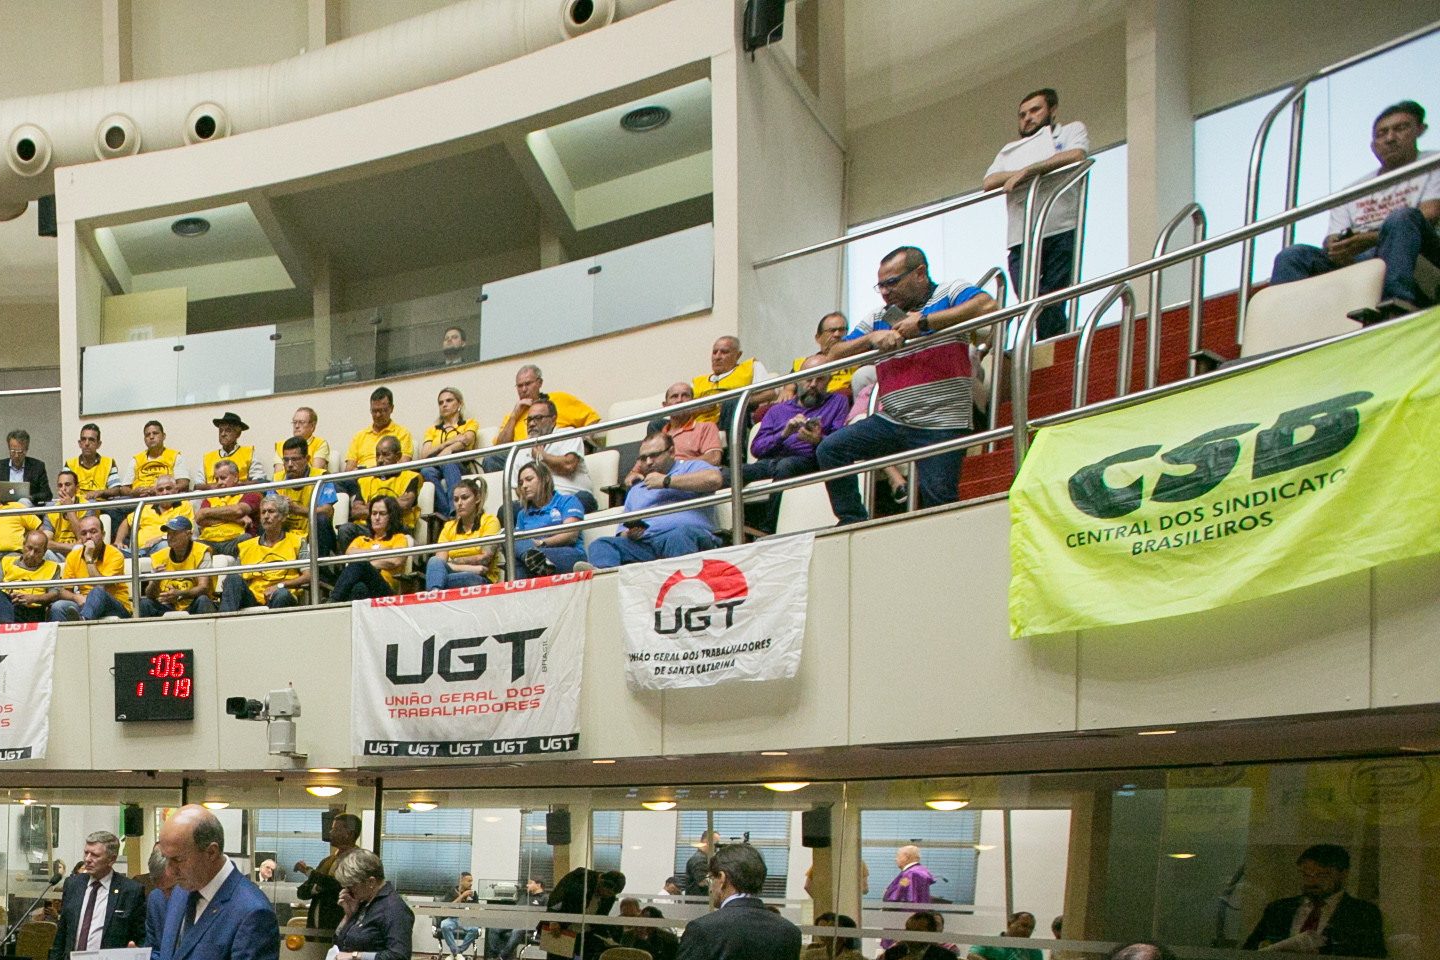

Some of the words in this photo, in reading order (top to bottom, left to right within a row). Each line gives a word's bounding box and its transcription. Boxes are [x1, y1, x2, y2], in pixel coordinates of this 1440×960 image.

[1067, 390, 1375, 519] CSB
[1065, 519, 1153, 549] CENTRAL
[1158, 506, 1205, 532] DOS
[1211, 466, 1350, 519] SINDICATO
[1131, 510, 1274, 556] BRASILEIROS
[416, 589, 448, 601] UGT
[459, 584, 491, 596] UGT
[504, 577, 536, 590] UGT
[653, 598, 747, 635] UGT
[385, 627, 548, 686] UGT
[653, 652, 680, 662] GERAL
[682, 650, 699, 661] DOS
[701, 638, 772, 658] TRABALHADORES
[654, 666, 665, 676] DE
[667, 664, 695, 675] SANTA
[696, 659, 736, 674] CATARINA
[384, 692, 432, 706] UNIÃO
[439, 690, 497, 704] GERAL
[506, 684, 546, 699] DOS
[387, 698, 541, 719] TRABALHADORES
[368, 742, 398, 755] UGT
[408, 743, 440, 756] UGT
[449, 742, 483, 756] UGT
[493, 740, 528, 754] UGT
[539, 736, 574, 751] UGT
